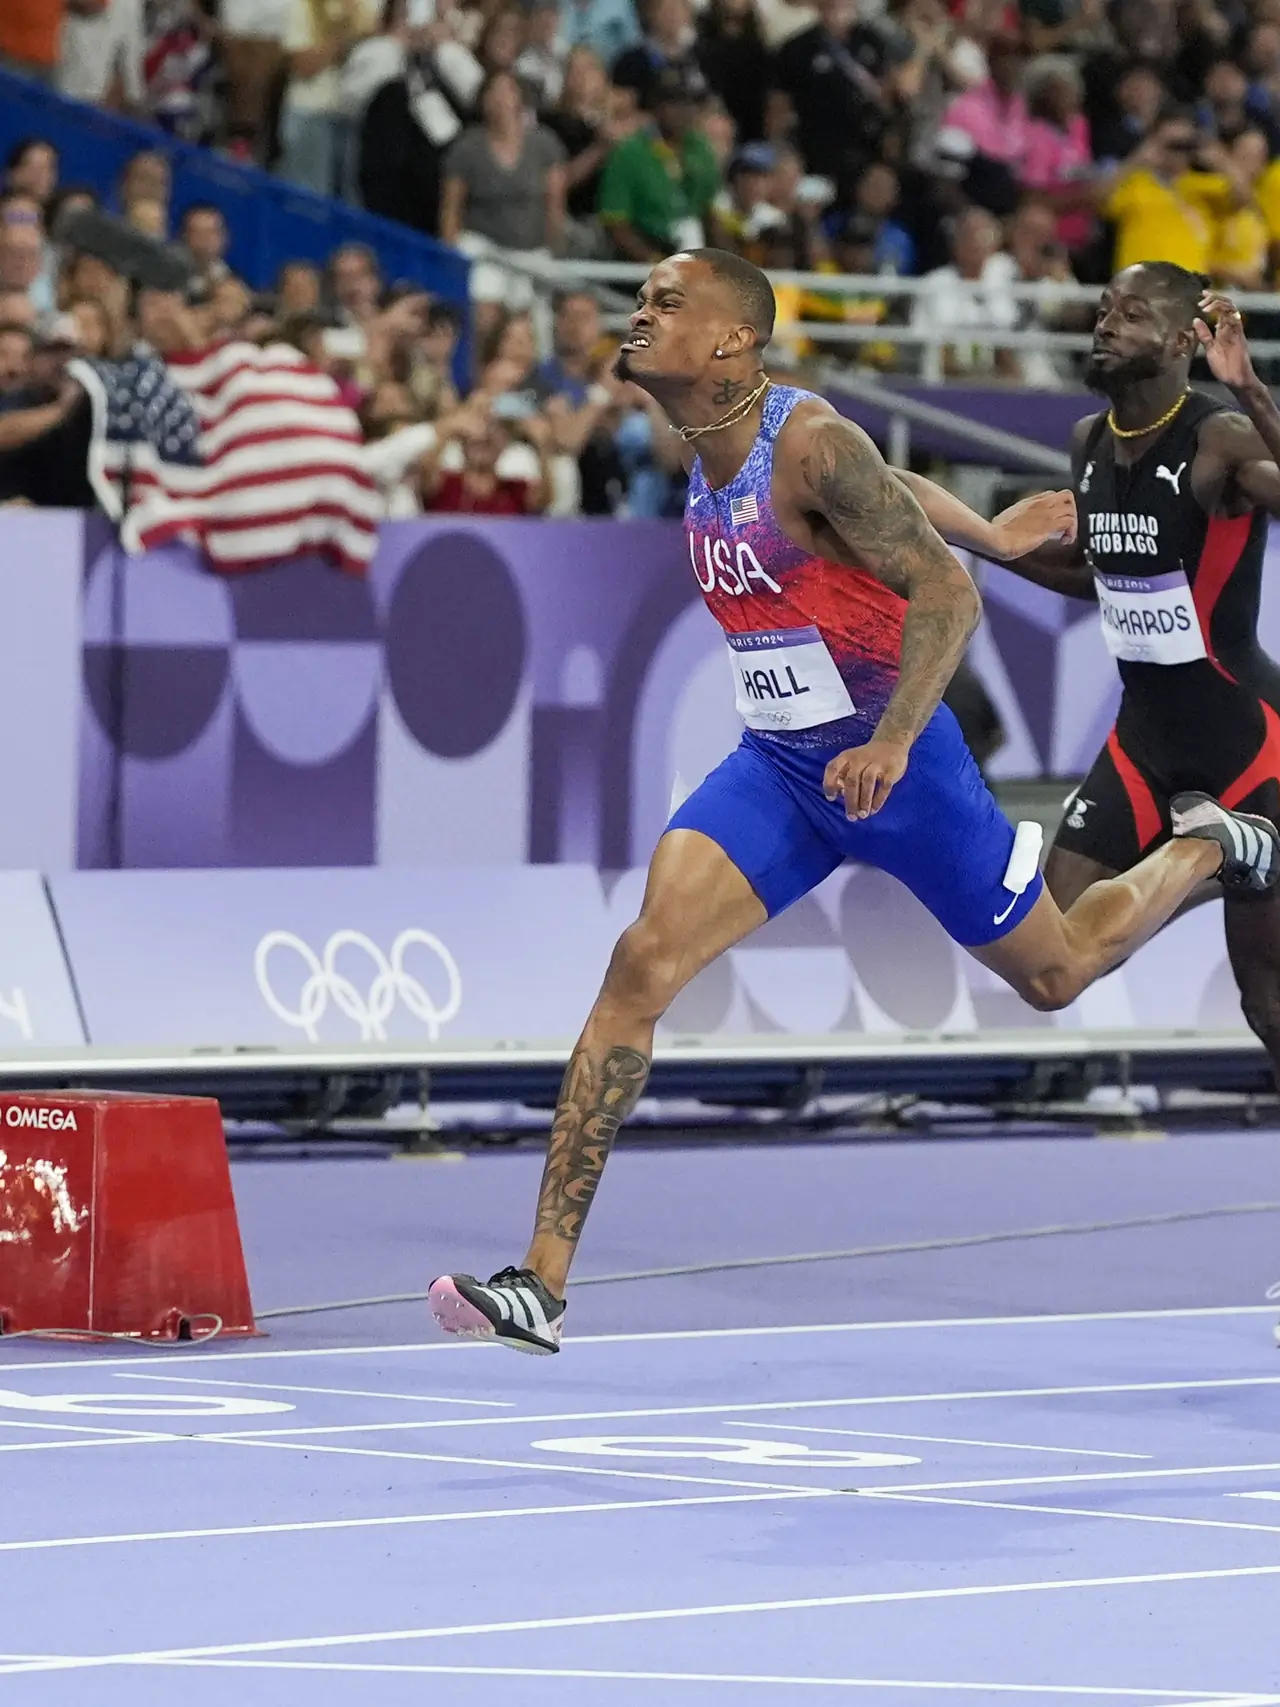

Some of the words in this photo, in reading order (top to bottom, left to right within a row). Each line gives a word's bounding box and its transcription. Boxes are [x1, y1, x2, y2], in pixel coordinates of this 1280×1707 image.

[1088, 512, 1159, 537] TRINIDAD
[1095, 532, 1158, 556] TOBAGO
[689, 531, 782, 595] USA
[755, 634, 784, 646] 2024
[740, 665, 811, 700] HALL
[5, 1105, 78, 1131] OMEGA
